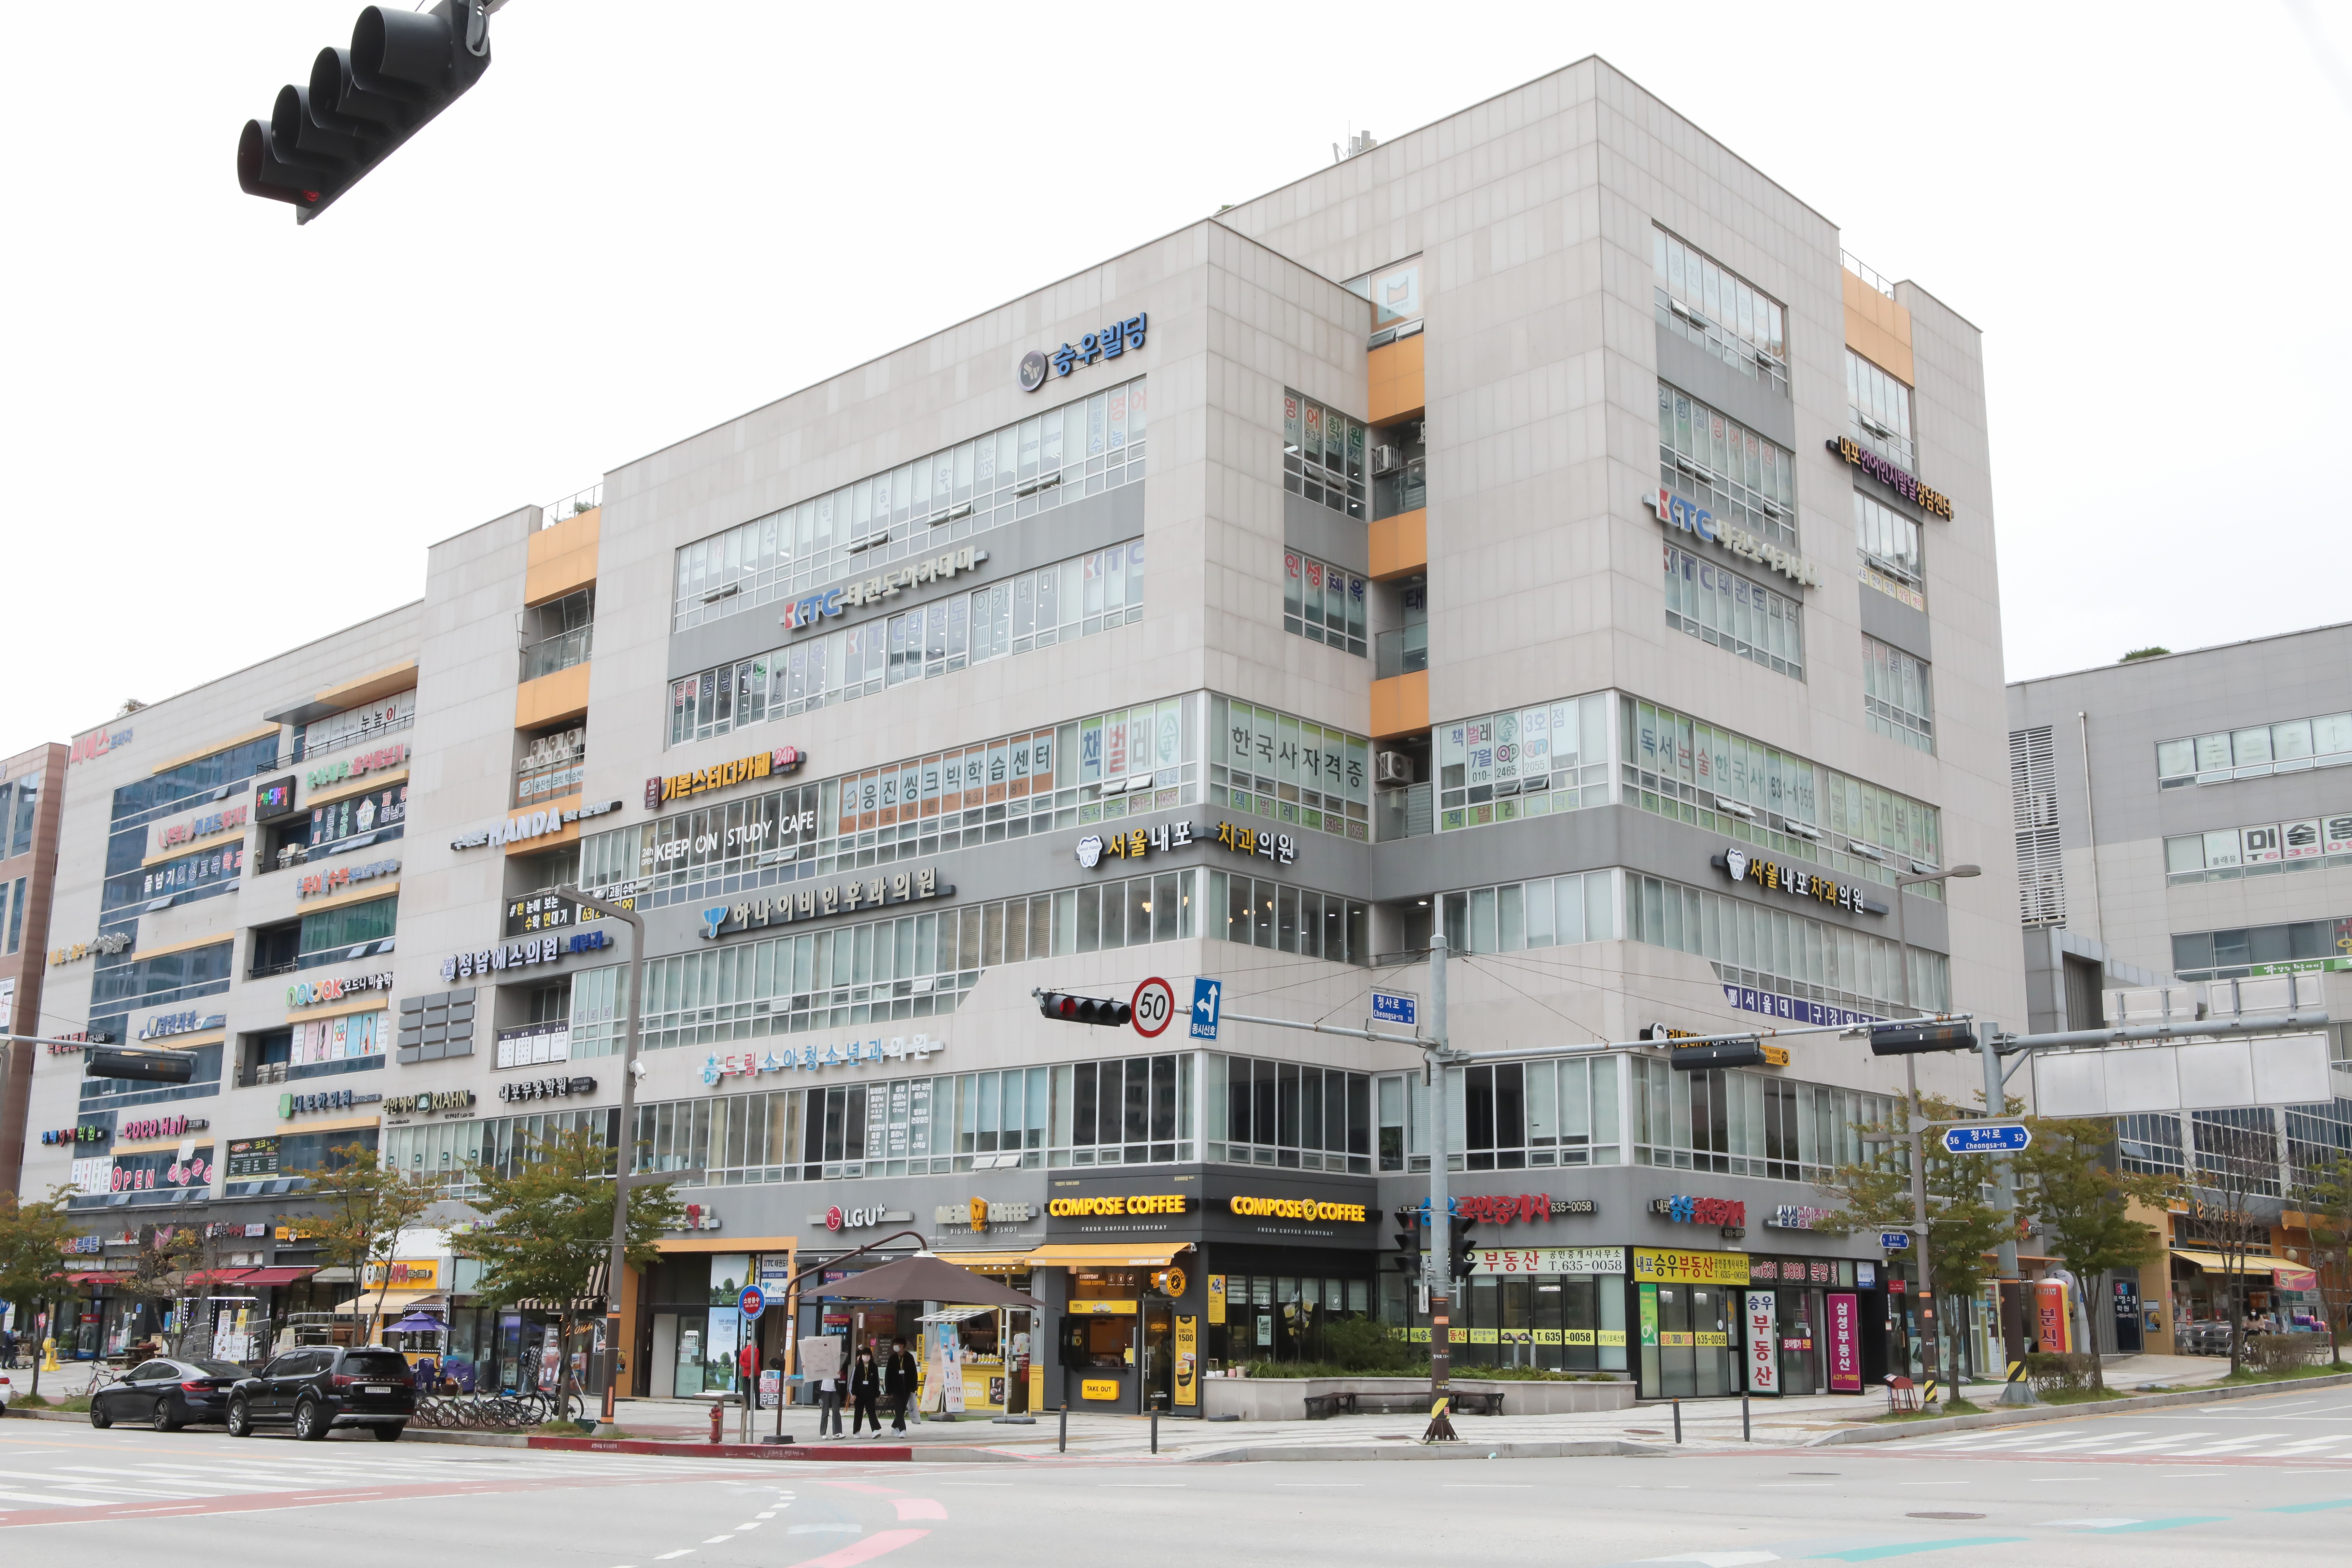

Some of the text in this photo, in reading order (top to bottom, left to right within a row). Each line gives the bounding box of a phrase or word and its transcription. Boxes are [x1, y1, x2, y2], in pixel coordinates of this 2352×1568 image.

[1052, 312, 1147, 376] 승우빌딩
[1284, 397, 1362, 447] 영어학원
[1712, 417, 1773, 467] 영어학원
[1656, 488, 1821, 588] KTC 태권도아카데미
[1085, 542, 1144, 580] KTC
[1664, 546, 1714, 591] KTC
[784, 546, 975, 630] KTC 태권도아카데미
[1284, 554, 1363, 602] 인성체육
[1872, 574, 1921, 608] 언어 인지 상담 센터
[848, 617, 905, 655] KTC
[1525, 708, 1564, 732] 3호점
[70, 728, 109, 764] 씨에스
[1232, 727, 1362, 788] 한국사자격증
[1469, 748, 1491, 768] 7월
[535, 776, 564, 792] 웅진씽크빅
[662, 746, 798, 800] 기본스터디카페 24h
[1157, 770, 1178, 784] 학원
[1235, 791, 1293, 821] 책벌레
[1554, 792, 1577, 807] 학원
[488, 807, 561, 847] HANDA
[656, 811, 814, 862] KEEP ON STUDY CAFE
[642, 847, 653, 857] 24h
[1108, 821, 1191, 859] 서울내포
[1218, 821, 1293, 864] 치과의원
[144, 868, 176, 892] 줄넘기
[177, 856, 221, 885] 인성교육
[641, 857, 653, 866] OPEN
[303, 874, 322, 893] 국어
[328, 867, 349, 888] 수학
[609, 883, 634, 898] 고등 수학
[1750, 859, 1864, 914] 서울내포치과의원
[526, 899, 540, 914] 눈에
[544, 895, 558, 909] 보는
[734, 867, 936, 929] 하나이비인후과의원
[525, 909, 567, 930] 수학 연대기
[460, 930, 603, 977] 청담에스의원 피부과
[344, 978, 367, 991] 모드니
[1139, 993, 1166, 1021] 50
[1377, 995, 1399, 1009] 청사로
[1745, 991, 1789, 1018] 서울대
[158, 1010, 196, 1035] 열린치과
[1374, 1010, 1403, 1021] Cheongsa-ro
[1192, 1023, 1215, 1037] 동시신호
[704, 1033, 929, 1083] Dr 드림소아청소년과의원
[293, 1090, 352, 1112] 내포한의원
[501, 1077, 568, 1102] 내포무용학원
[383, 1090, 469, 1115] 리안헤어 RIAHN
[124, 1115, 188, 1139] COCO Hair
[1971, 1130, 2001, 1141] 청사로
[1966, 1142, 2007, 1150] Cheongsa-ro
[111, 1167, 155, 1192] OPEN
[988, 1202, 1029, 1222] COFFEE
[1050, 1195, 1185, 1216] COMPOSE COFFEE
[1231, 1196, 1365, 1222] COMPOSE COFFEE
[1551, 1201, 1592, 1212] 635-0058
[1725, 1229, 1745, 1237] 635-0058
[1484, 1250, 1621, 1272] 부동산 공인중개사사무소
[1549, 1261, 1622, 1271] T.635-0058
[1783, 1263, 1828, 1281] 9880 분양
[1167, 1268, 1185, 1280] COMPOSE
[1169, 1286, 1184, 1295] COFFEE
[1748, 1296, 1773, 1310] 승우
[1545, 1332, 1560, 1341] 635
[1697, 1335, 1725, 1344] 635-0058
[1837, 1303, 1851, 1371] 삼성부동산
[2040, 1308, 2057, 1348] 분식
[1752, 1316, 1772, 1386] 부동산
